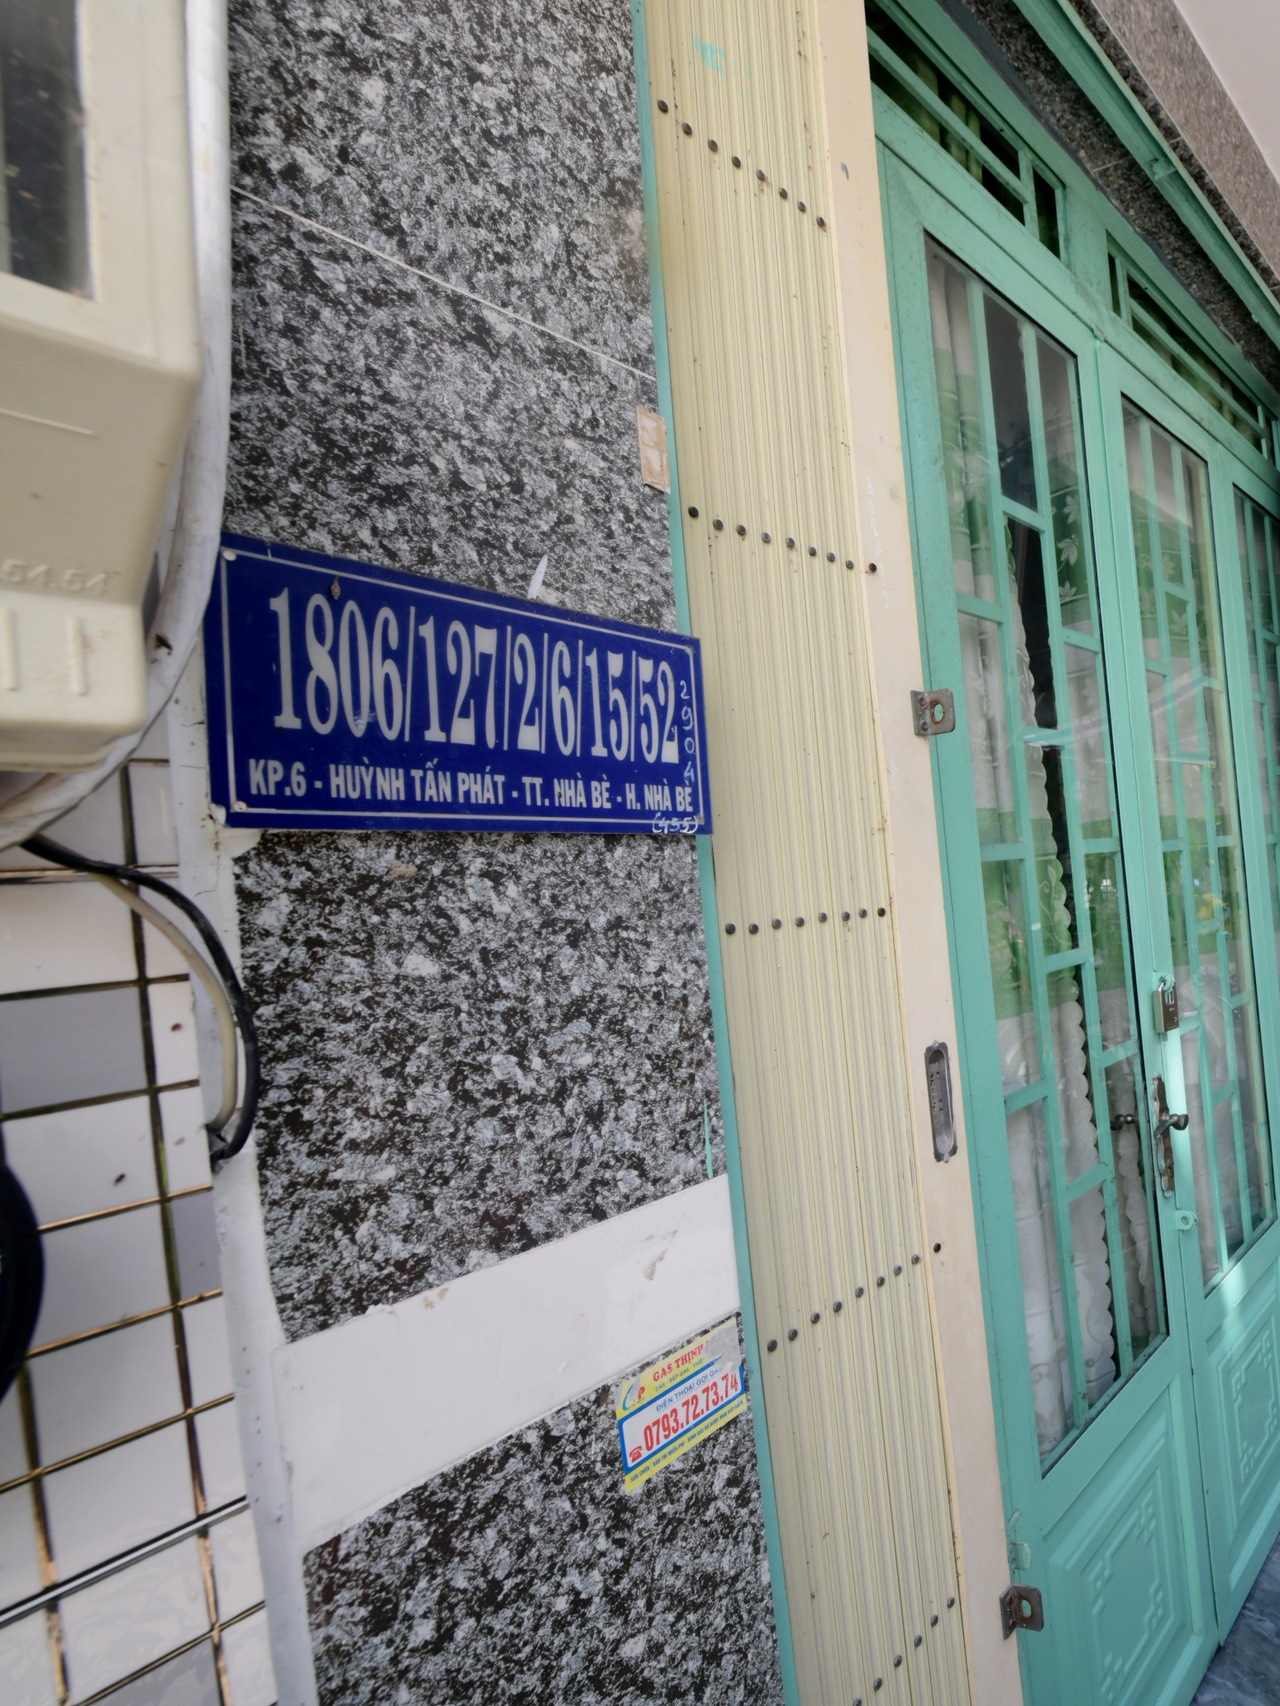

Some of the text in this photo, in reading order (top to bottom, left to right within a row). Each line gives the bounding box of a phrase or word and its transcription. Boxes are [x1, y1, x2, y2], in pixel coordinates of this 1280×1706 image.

[269, 587, 680, 764] 1806/127/2/6/15/52
[248, 758, 307, 797] KP.6
[329, 756, 406, 801] HUỲNH
[410, 758, 453, 803] TẤN
[456, 766, 506, 805] PHÁT
[521, 776, 550, 807] TT.
[553, 772, 587, 808] NHÀ
[590, 774, 612, 809] BÈ
[625, 783, 641, 810] H.
[643, 778, 673, 812] NHÀ
[675, 780, 694, 812] BÈ
[652, 1363, 673, 1382] GAS
